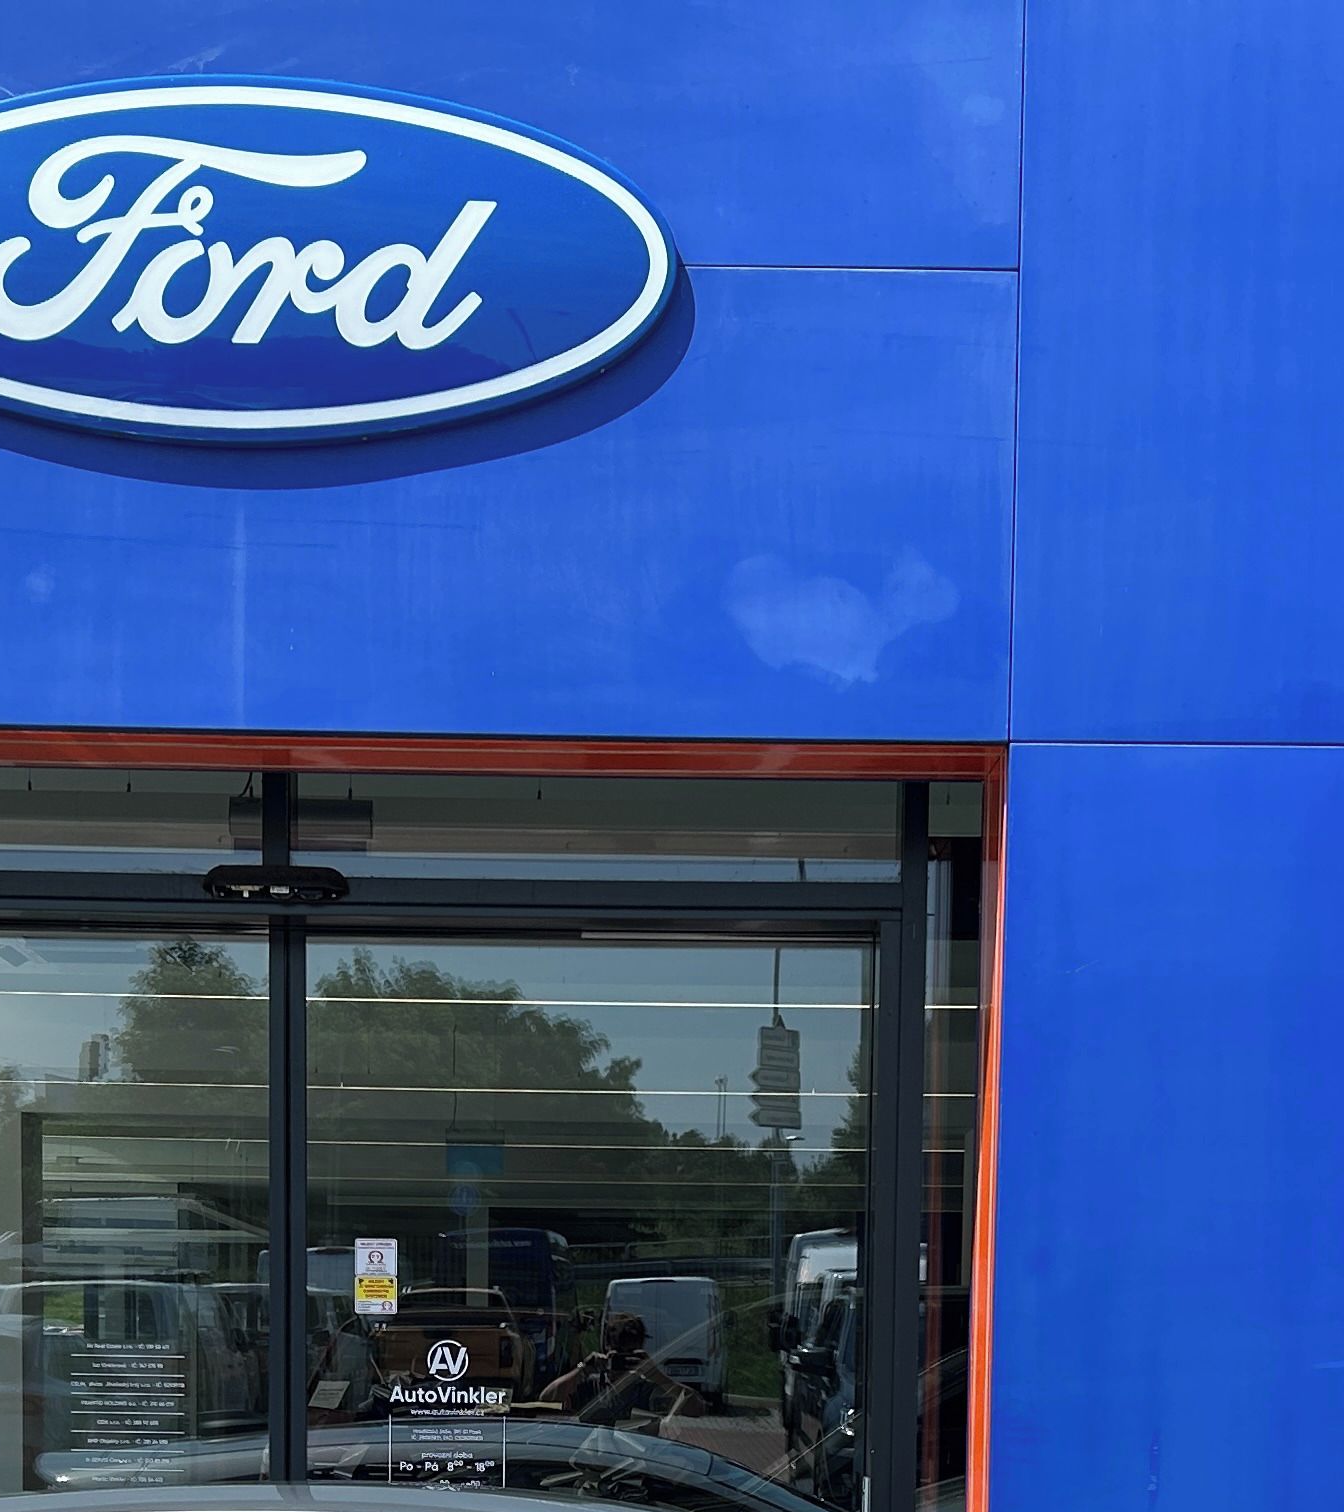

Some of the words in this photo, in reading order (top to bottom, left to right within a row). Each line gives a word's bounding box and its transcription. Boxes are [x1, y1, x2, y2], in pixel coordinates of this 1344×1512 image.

[429, 1346, 467, 1375] AV
[390, 1385, 506, 1404] AutoVinkler
[399, 1461, 414, 1472] Po
[424, 1461, 439, 1472] Pá
